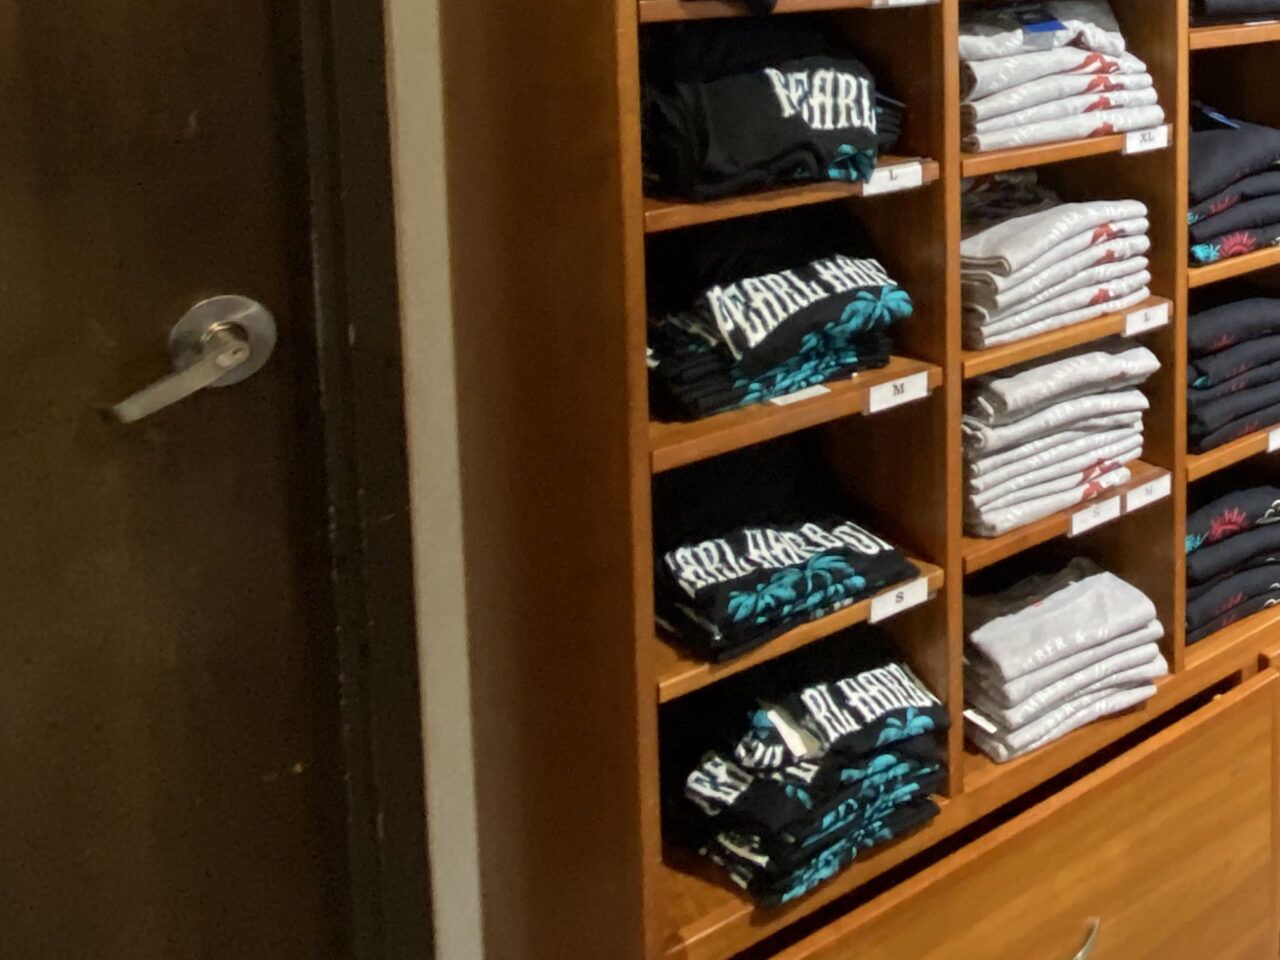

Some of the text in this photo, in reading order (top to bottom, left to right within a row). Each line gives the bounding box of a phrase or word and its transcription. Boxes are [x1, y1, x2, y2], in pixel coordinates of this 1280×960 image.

[764, 67, 878, 136] PEARL
[1139, 130, 1155, 142] XL
[889, 168, 898, 181] L
[706, 271, 829, 362] PEARL
[892, 383, 906, 396] M
[894, 590, 905, 604] S
